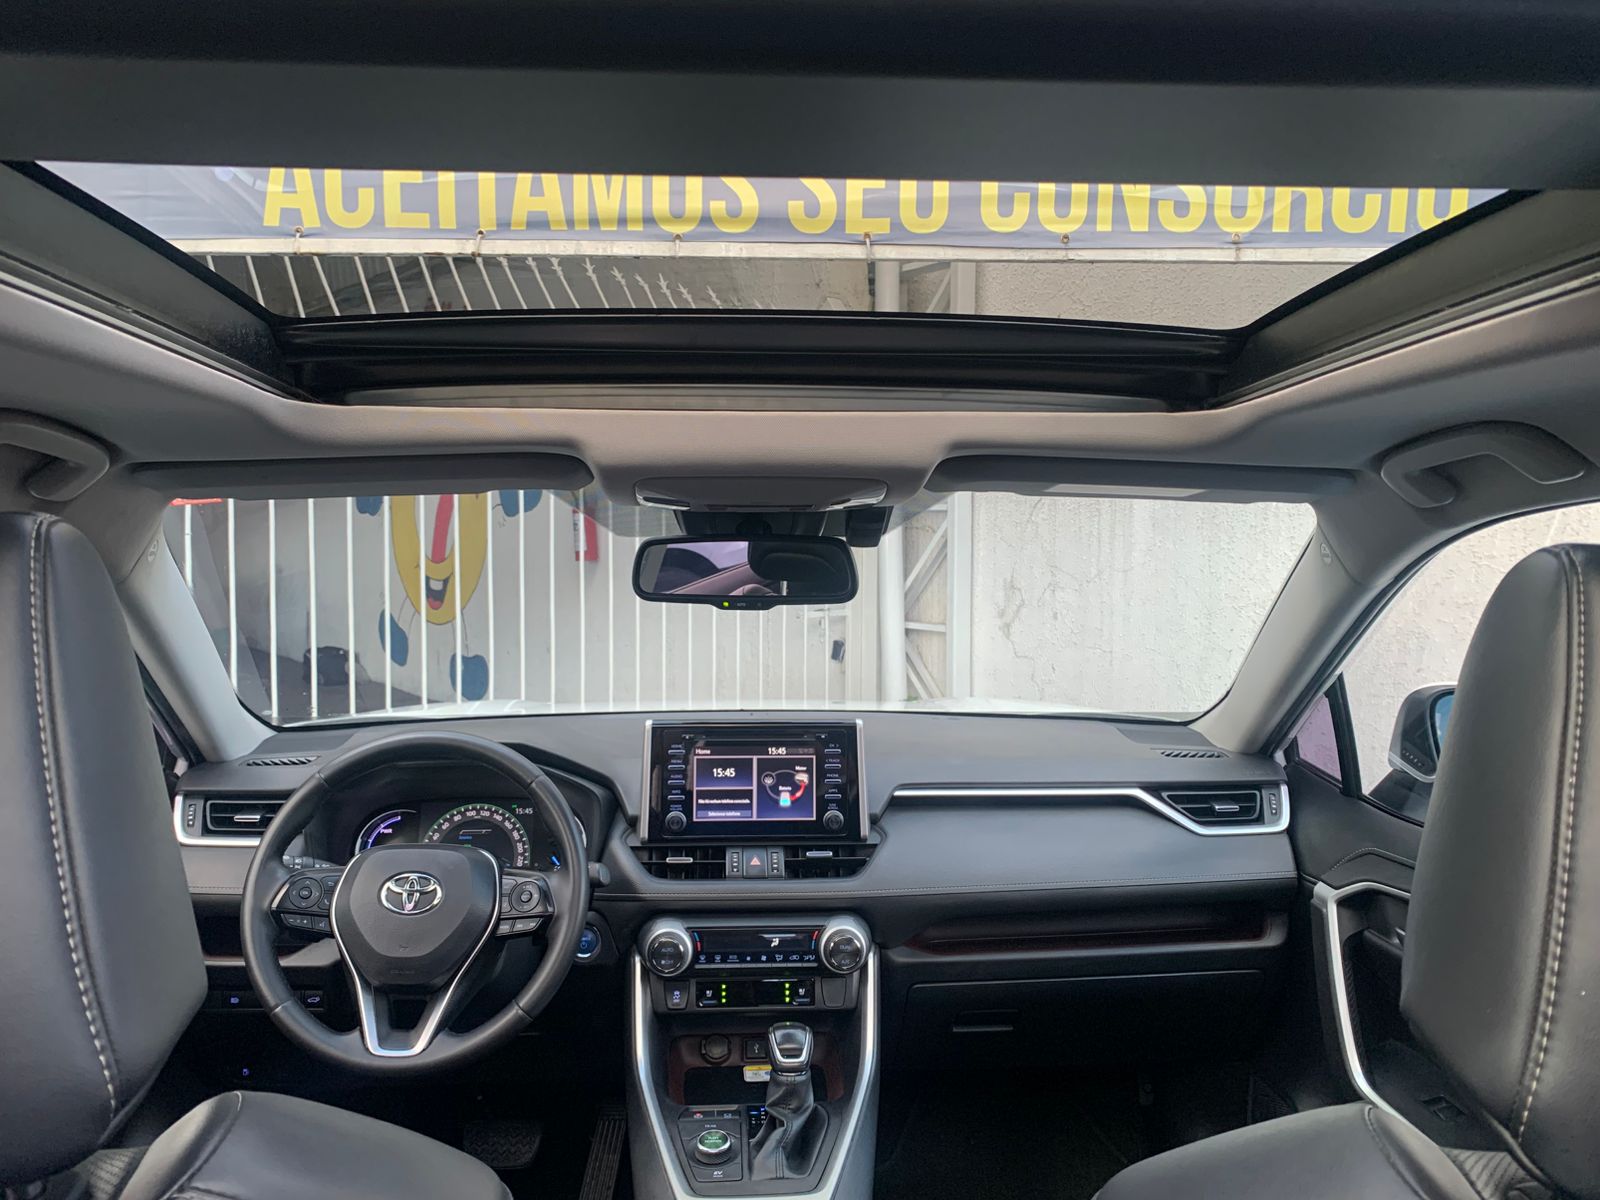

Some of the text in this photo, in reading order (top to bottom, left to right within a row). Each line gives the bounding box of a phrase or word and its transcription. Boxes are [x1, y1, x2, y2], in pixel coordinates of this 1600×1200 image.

[788, 177, 949, 234] SEU
[767, 747, 787, 755] 15:45
[712, 767, 736, 778] 15:45
[515, 807, 533, 815] 15:45
[453, 814, 462, 822] 80
[493, 813, 503, 821] 140
[503, 820, 513, 830] 160
[511, 830, 520, 840] 180
[516, 842, 524, 853] 200
[516, 856, 524, 867] 220
